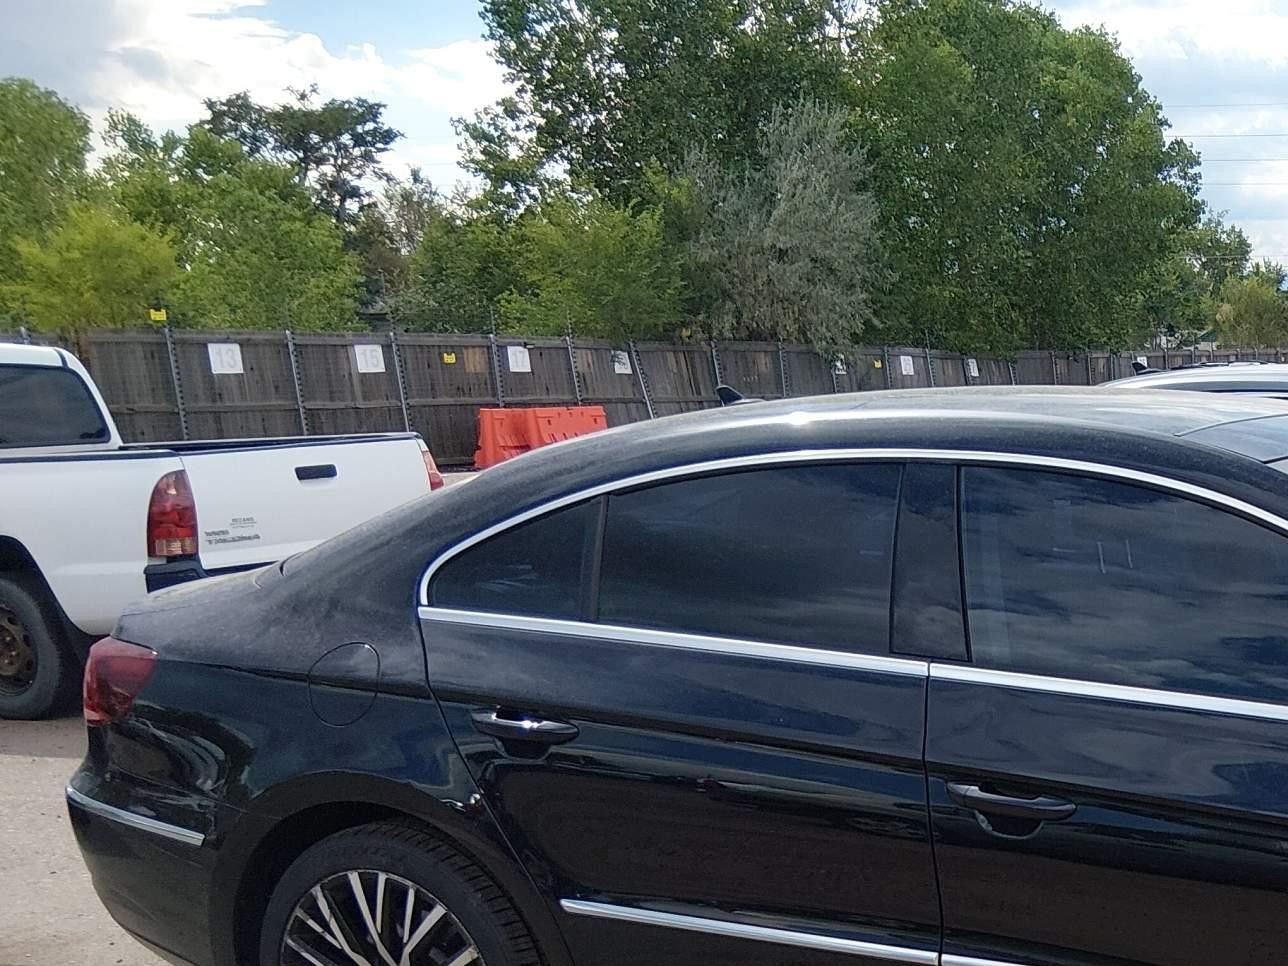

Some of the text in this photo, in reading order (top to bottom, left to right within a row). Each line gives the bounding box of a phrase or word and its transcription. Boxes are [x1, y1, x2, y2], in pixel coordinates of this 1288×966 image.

[215, 347, 238, 369] 13
[360, 348, 380, 369] 15
[511, 349, 527, 369] 17
